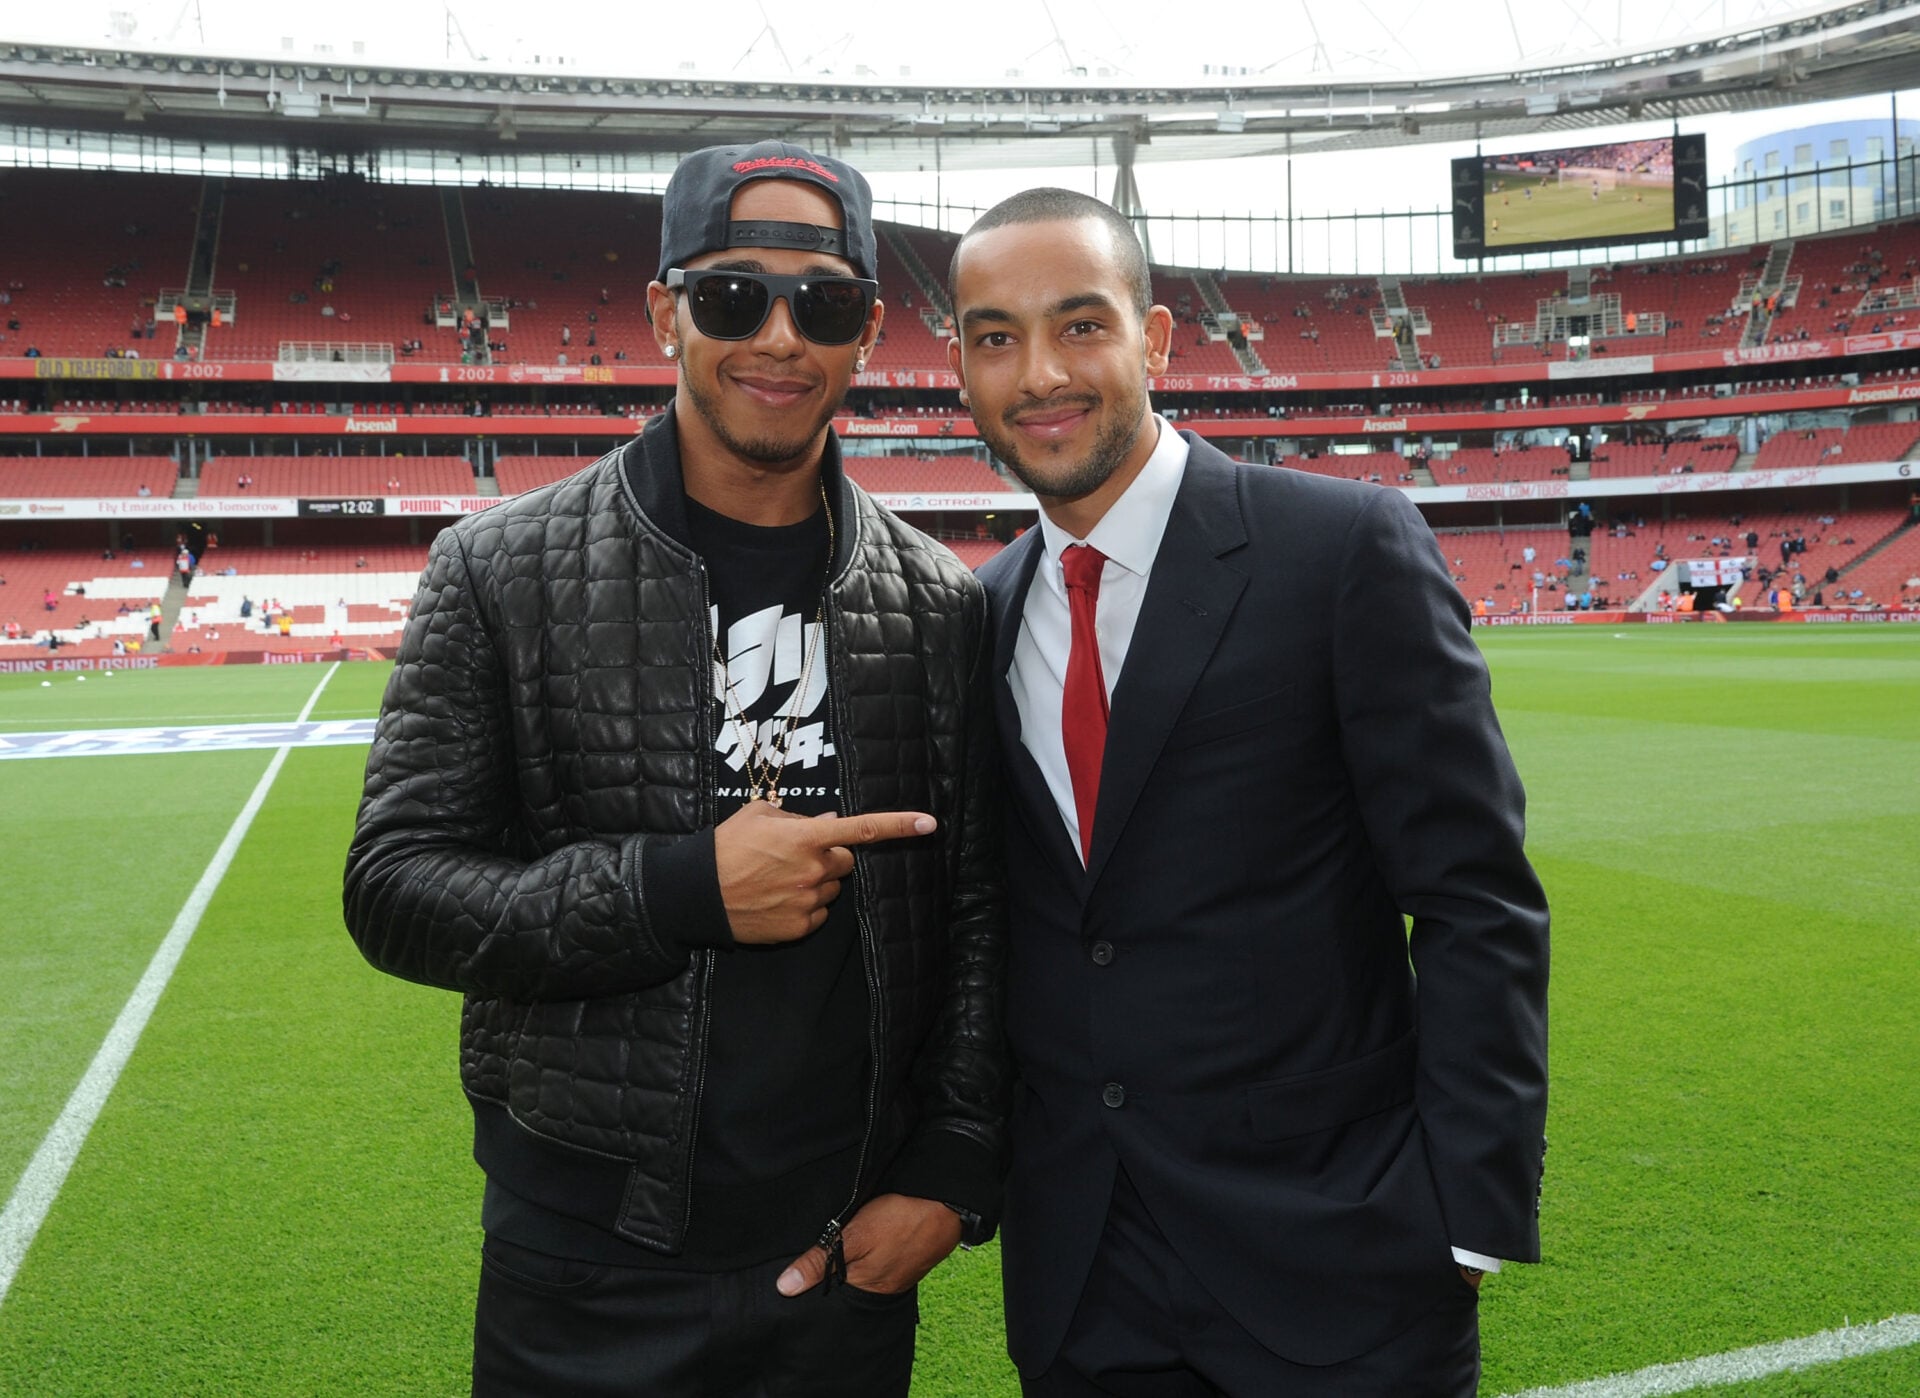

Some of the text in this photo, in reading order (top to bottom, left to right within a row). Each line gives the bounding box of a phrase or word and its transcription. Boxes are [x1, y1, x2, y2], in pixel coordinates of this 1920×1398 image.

[38, 360, 64, 378] OLD
[68, 360, 133, 379] TRAFFORD
[182, 364, 224, 378] 2002
[457, 367, 495, 381] 2002
[855, 372, 891, 387] WHL
[1163, 378, 1193, 390] 2005
[1262, 375, 1297, 388] 2004
[1389, 373, 1418, 385] 2014
[1848, 383, 1920, 404] Arsenal.co
[344, 417, 397, 432] Arsenal
[846, 420, 918, 435] Arsenal.com
[1362, 417, 1407, 432] Arsenal
[98, 502, 118, 515] Fly
[183, 501, 214, 512] Hello
[341, 501, 374, 513] 12:02
[400, 499, 442, 513] PUMA
[461, 499, 498, 513] PUM
[778, 787, 826, 796] BOYS
